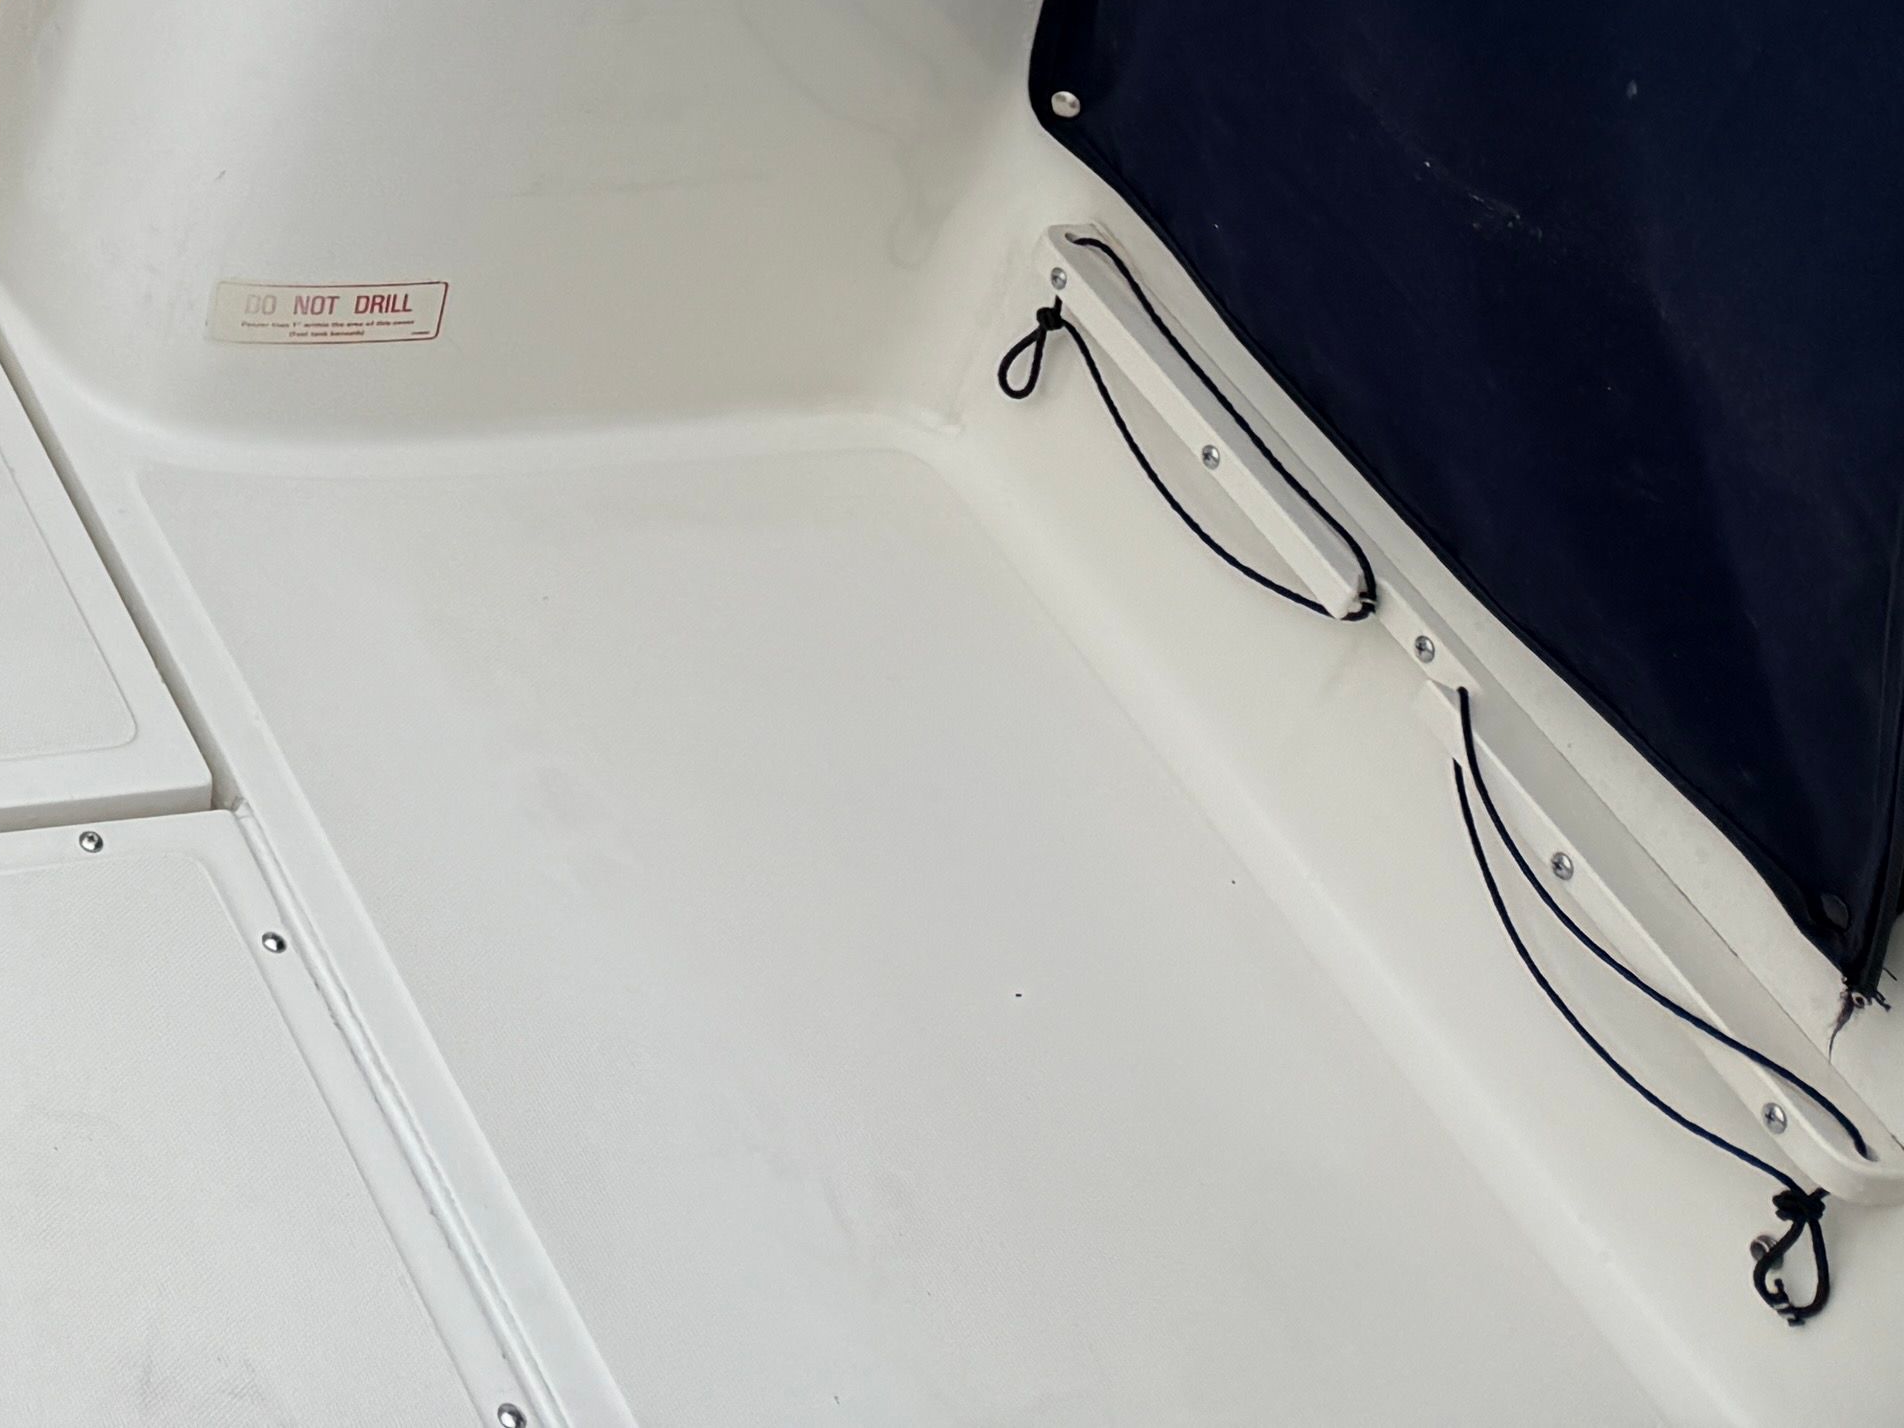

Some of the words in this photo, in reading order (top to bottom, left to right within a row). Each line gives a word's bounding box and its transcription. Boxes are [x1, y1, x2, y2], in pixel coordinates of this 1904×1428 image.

[244, 293, 278, 315] DO
[293, 294, 341, 315] NOT
[354, 293, 413, 314] DRILL
